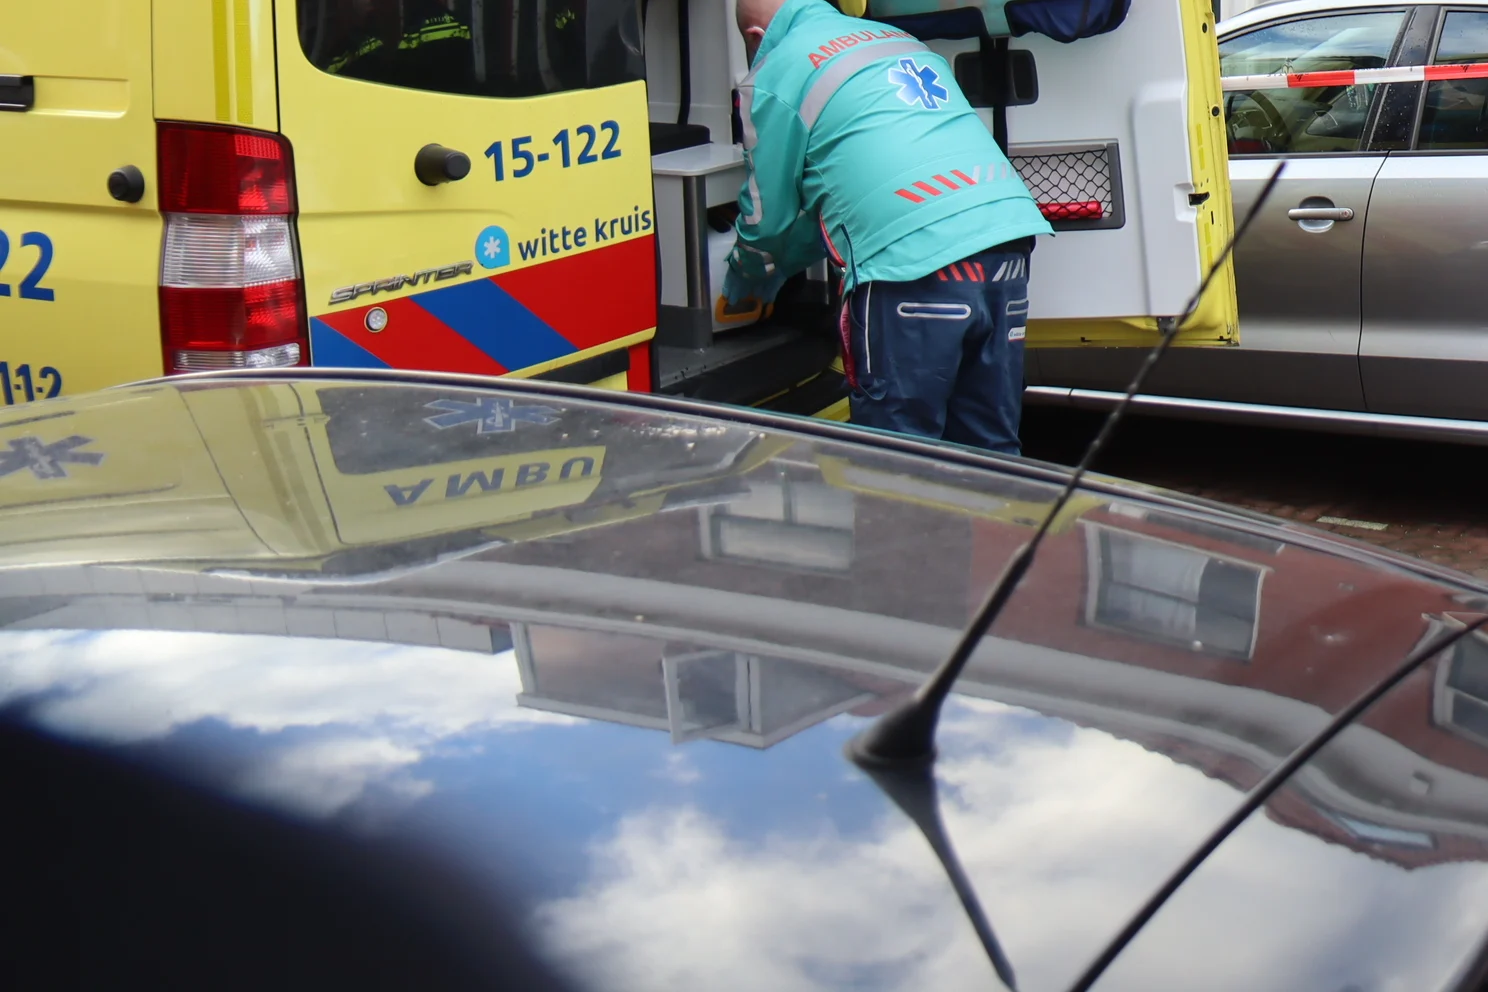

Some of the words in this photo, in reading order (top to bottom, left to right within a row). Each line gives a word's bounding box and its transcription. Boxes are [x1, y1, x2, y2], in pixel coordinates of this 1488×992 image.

[484, 119, 622, 182] 15-122
[518, 227, 587, 261] witte
[595, 205, 651, 242] kruis
[328, 259, 475, 306] SPRINTER
